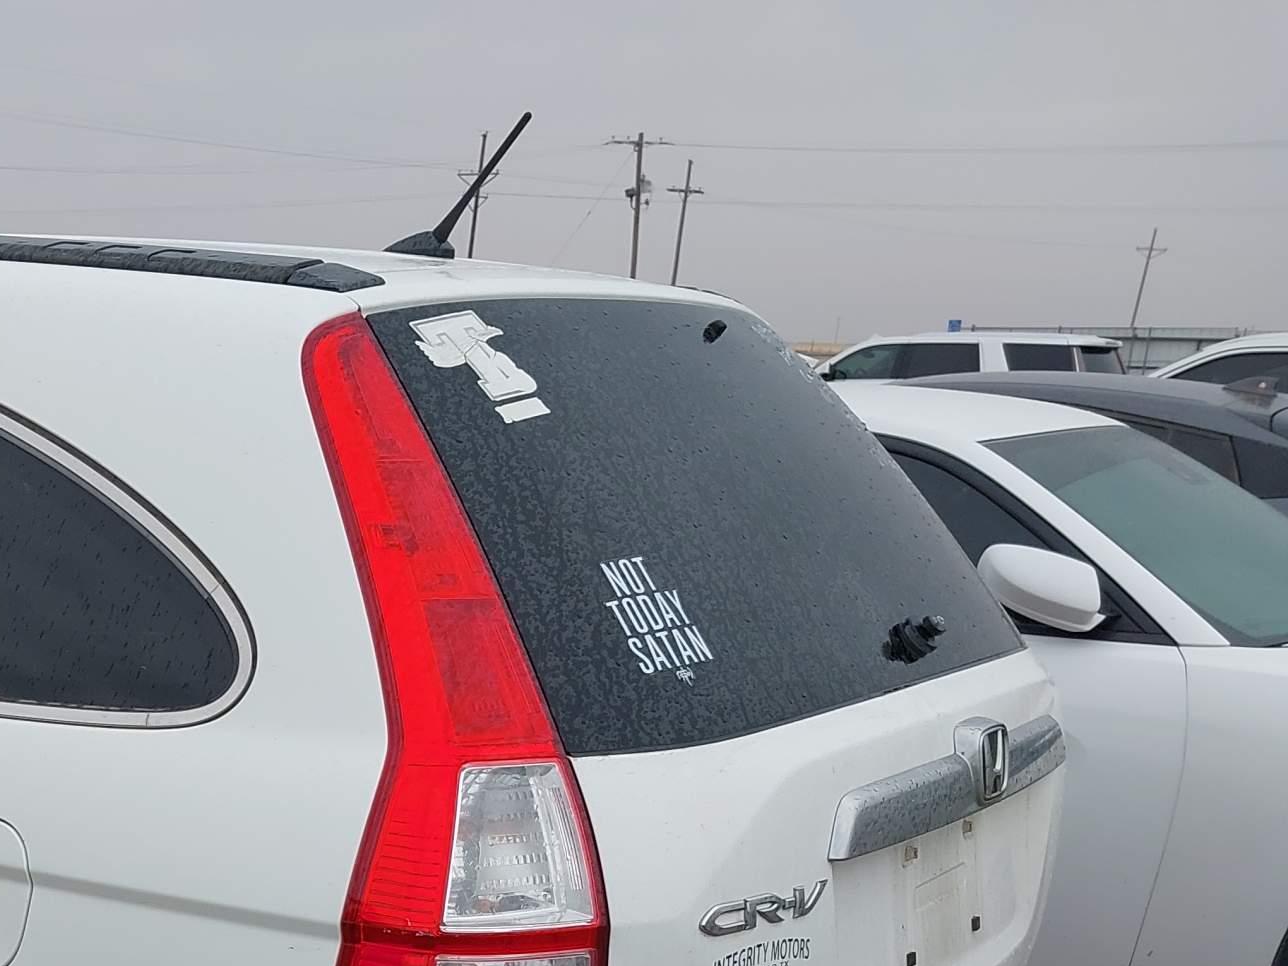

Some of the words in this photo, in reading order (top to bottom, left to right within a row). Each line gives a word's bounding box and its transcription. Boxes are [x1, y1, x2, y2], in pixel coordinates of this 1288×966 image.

[600, 556, 657, 597] NOT
[604, 589, 691, 636] TODAY
[627, 625, 714, 674] SATAN
[698, 878, 829, 938] CR-V
[770, 937, 811, 962] MOTORS
